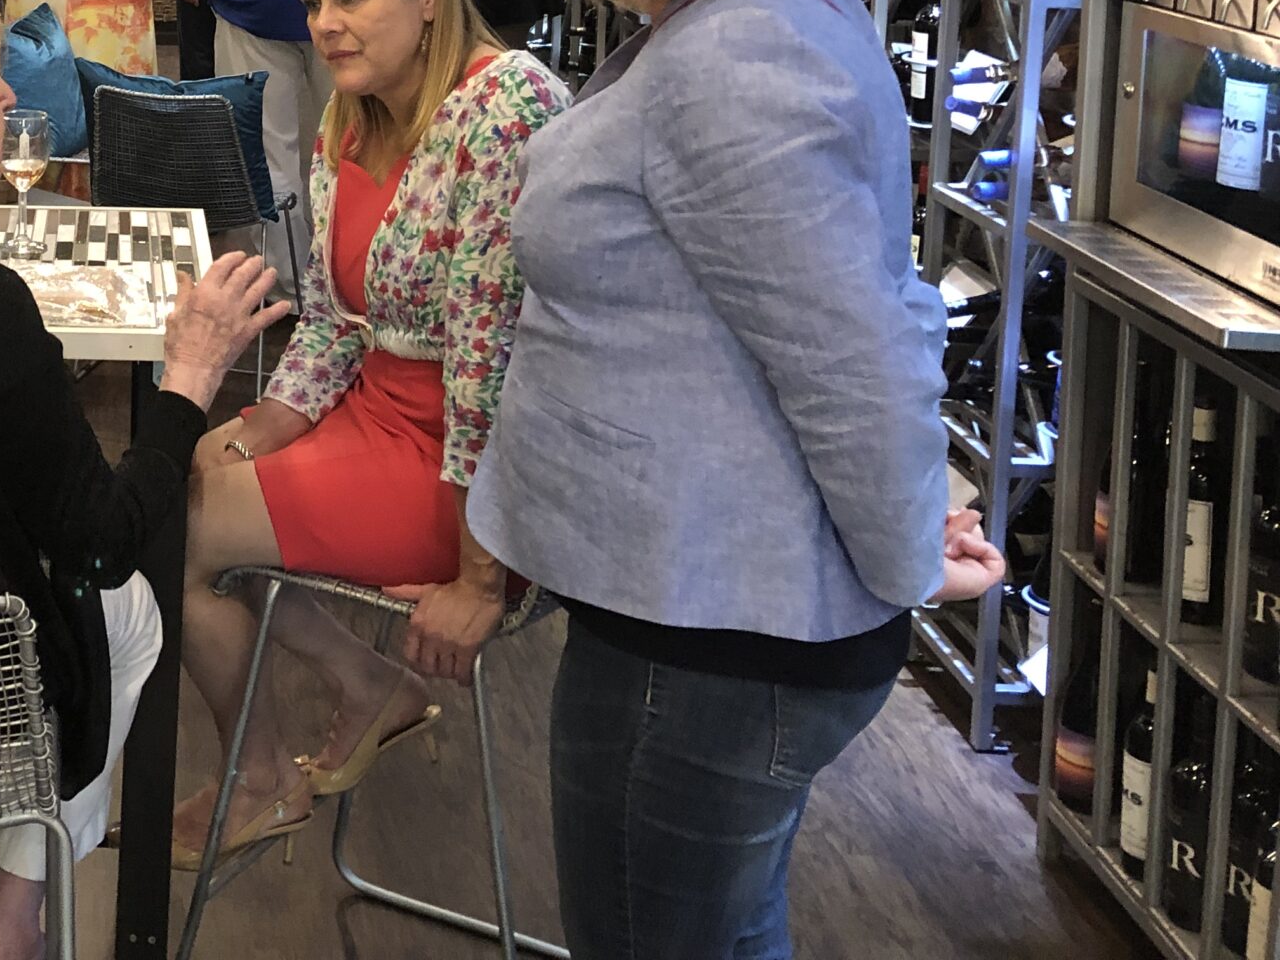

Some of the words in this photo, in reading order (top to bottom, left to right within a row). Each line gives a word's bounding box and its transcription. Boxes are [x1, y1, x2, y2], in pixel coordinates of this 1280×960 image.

[1221, 117, 1258, 133] MS
[1171, 837, 1201, 879] R
[1228, 863, 1254, 903] R
